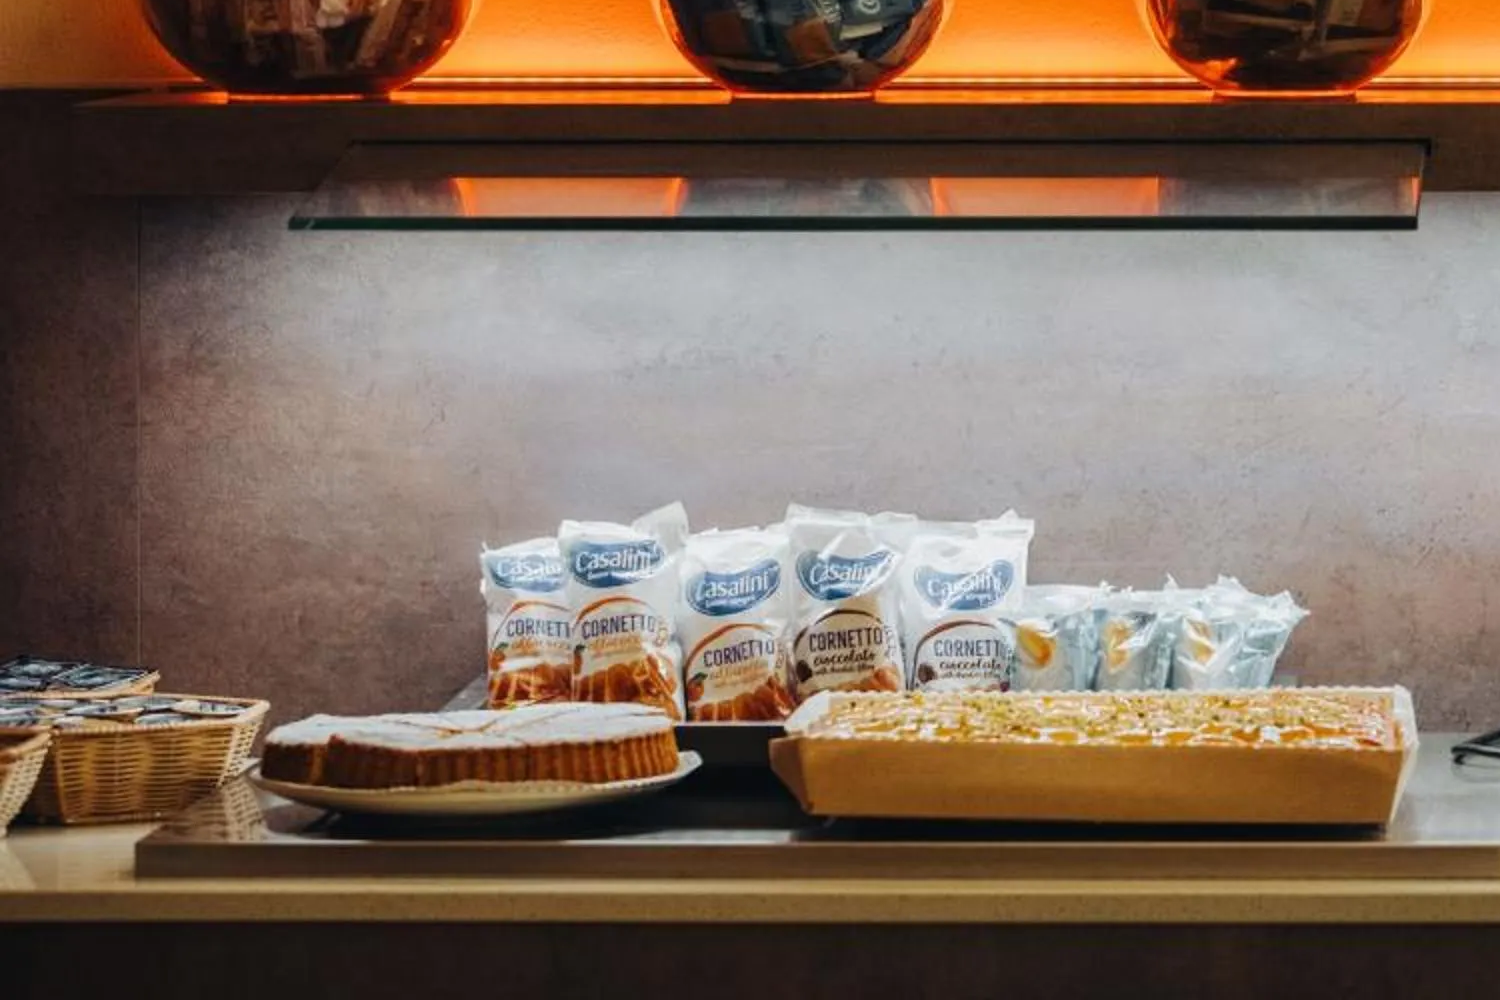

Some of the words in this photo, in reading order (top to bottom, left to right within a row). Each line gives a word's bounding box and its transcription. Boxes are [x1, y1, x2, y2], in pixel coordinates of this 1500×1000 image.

[507, 617, 570, 638] CORNETT
[581, 615, 656, 640] CORNETTO
[810, 627, 883, 653] CORNETTO
[703, 639, 775, 668] CORNETTO
[933, 639, 1001, 657] CORNETT
